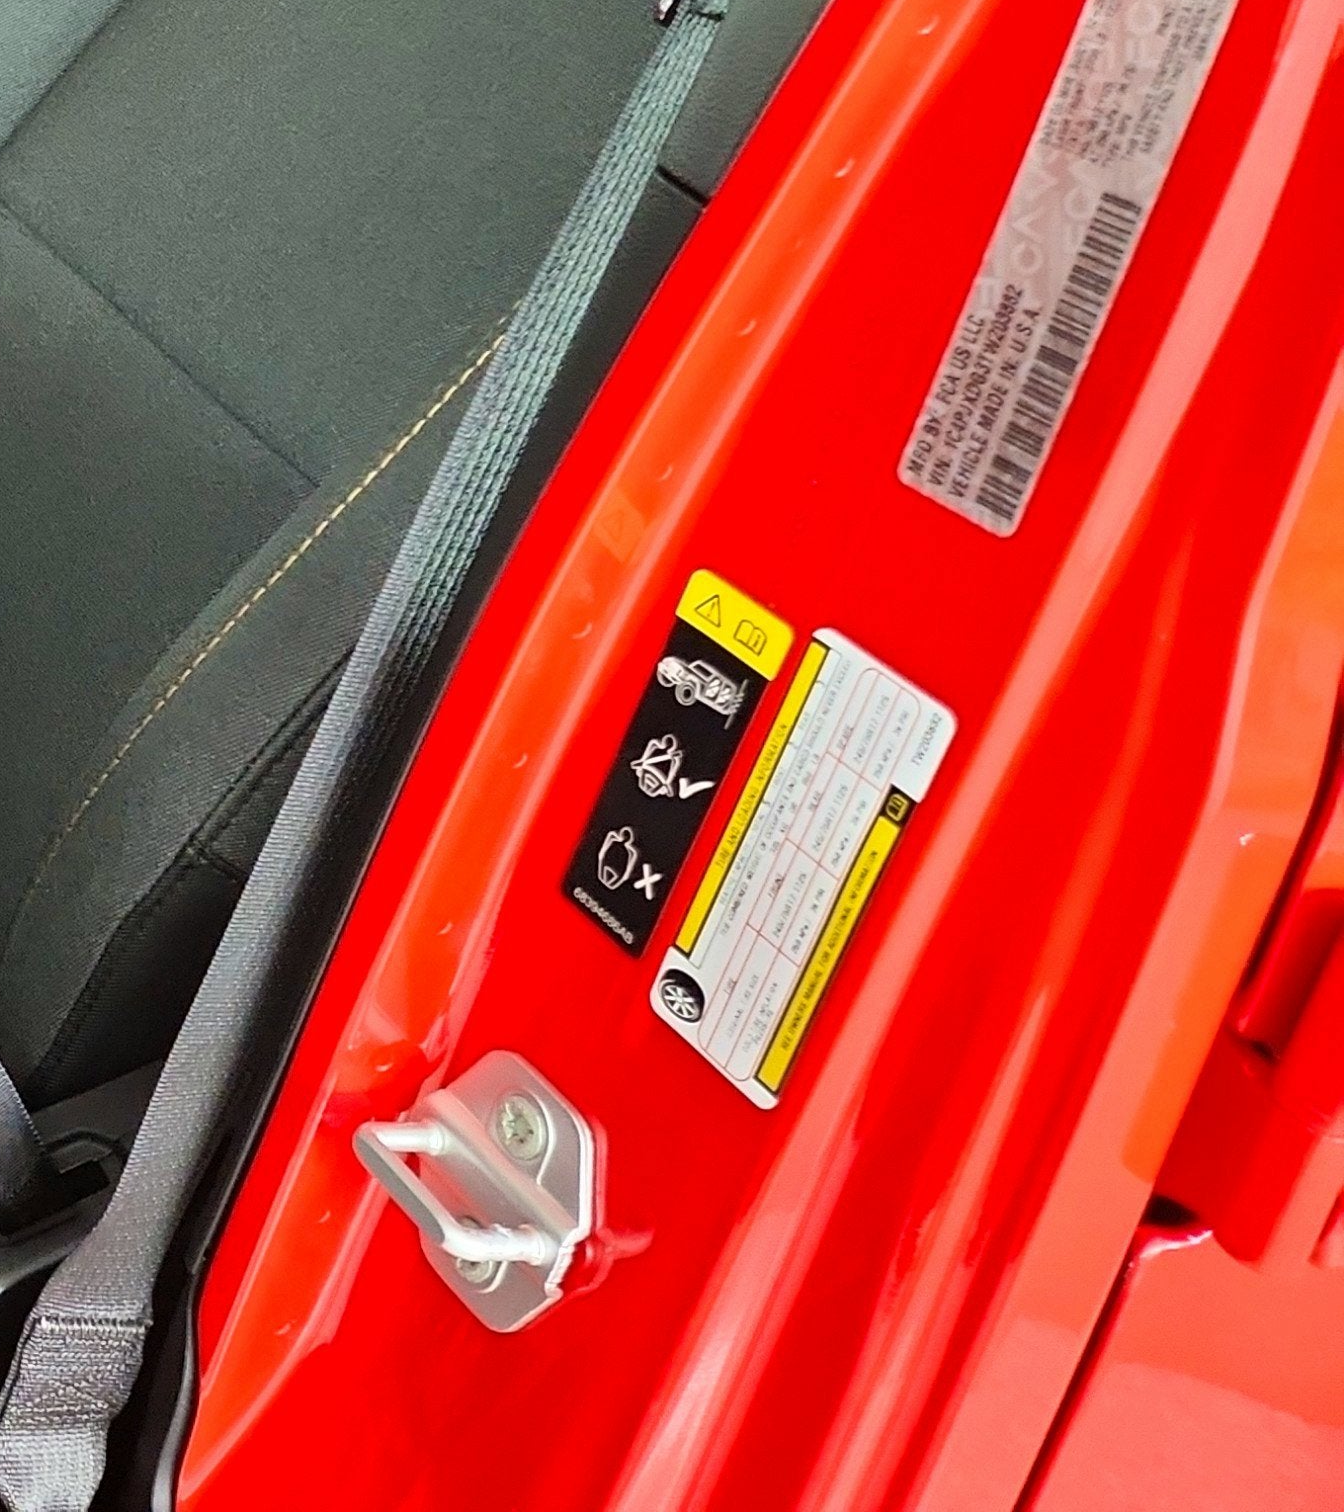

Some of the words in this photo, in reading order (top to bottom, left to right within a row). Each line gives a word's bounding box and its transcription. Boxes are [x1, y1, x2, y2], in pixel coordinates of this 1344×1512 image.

[905, 438, 934, 476] MFD
[934, 372, 961, 406] FCA
[958, 312, 986, 345] LLC
[947, 430, 989, 499] VEHICLE
[975, 383, 1008, 432] MADE
[926, 452, 954, 488] VIN:
